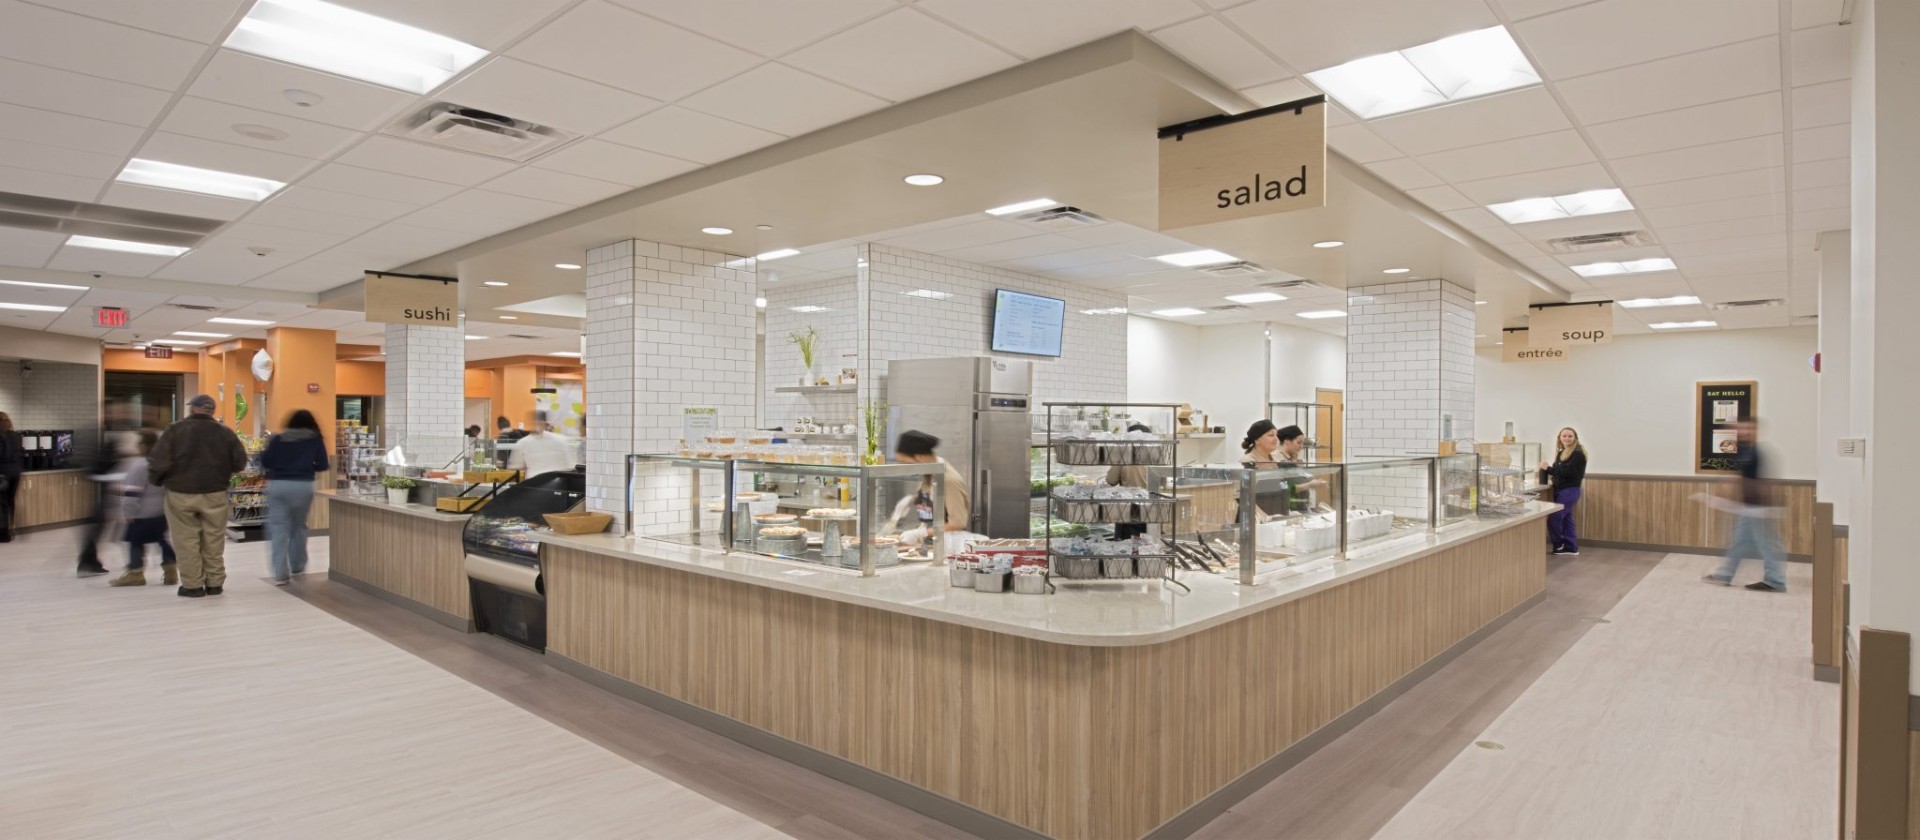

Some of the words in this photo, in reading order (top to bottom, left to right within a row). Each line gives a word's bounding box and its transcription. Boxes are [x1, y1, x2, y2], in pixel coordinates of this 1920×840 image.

[1217, 165, 1306, 209] salad
[99, 310, 125, 327] EXIT
[404, 306, 450, 321] sushi
[1562, 330, 1604, 343] soup
[150, 347, 169, 358] EXIT
[1517, 347, 1563, 359] entrée
